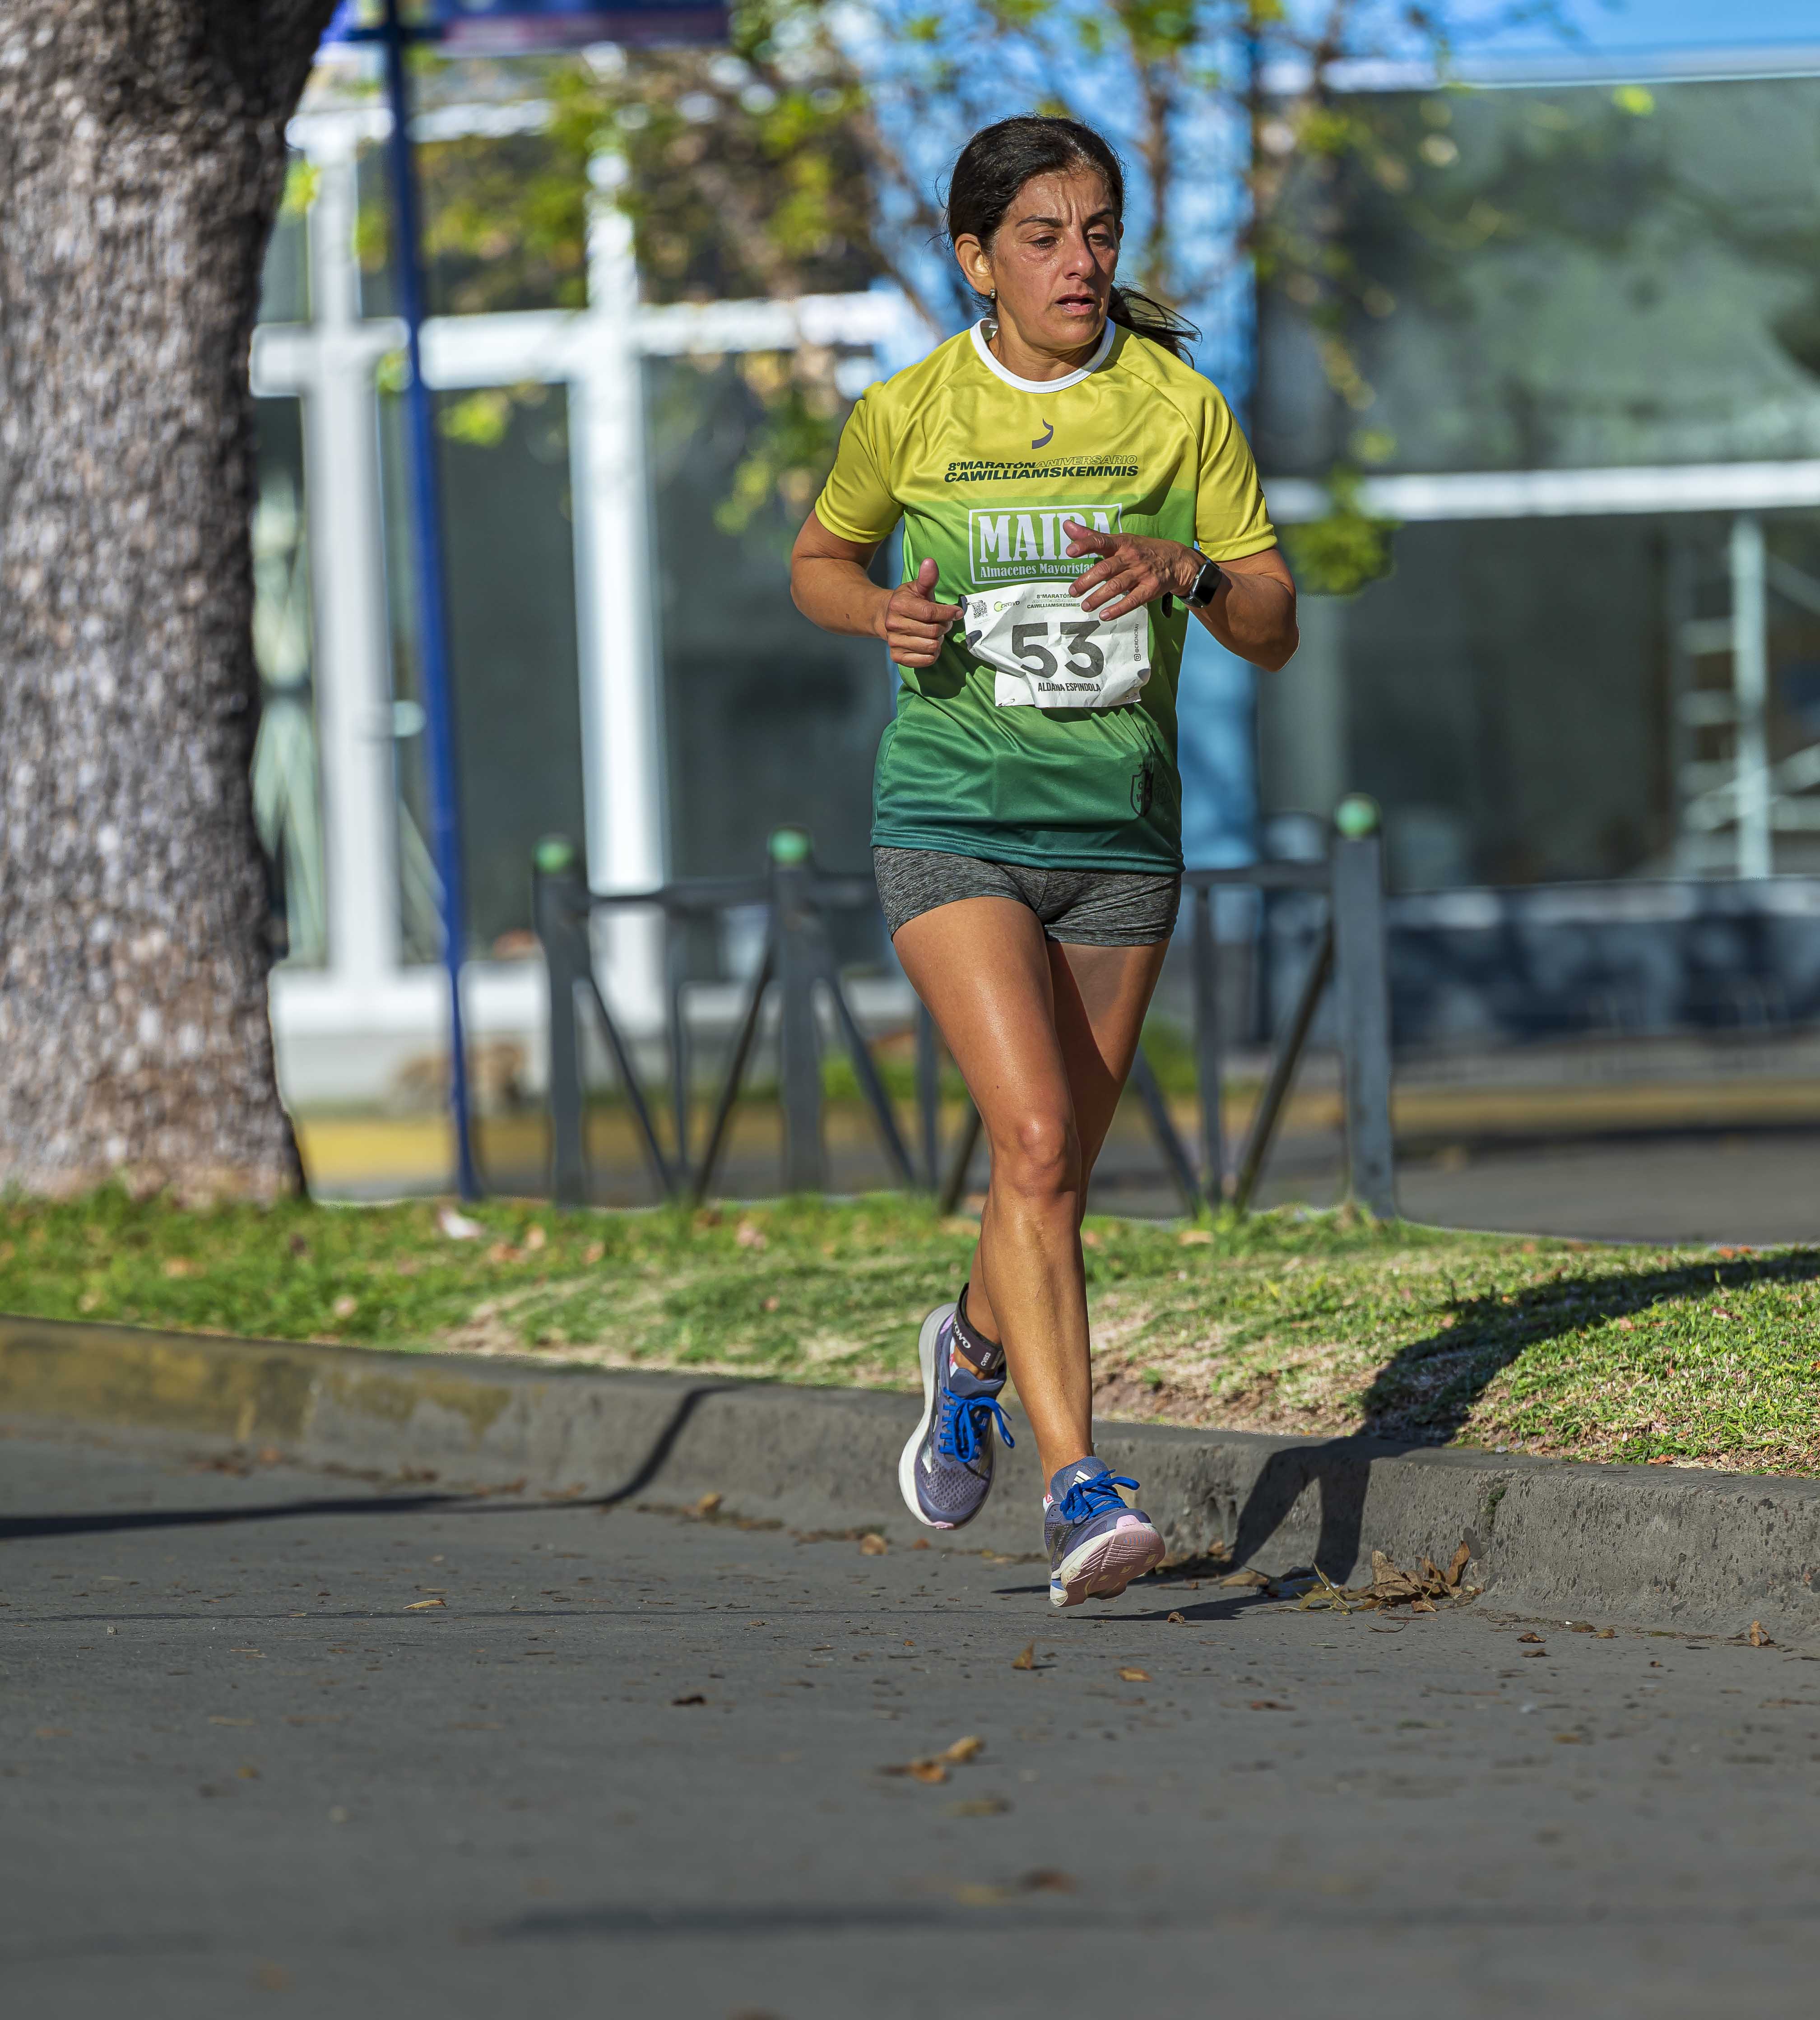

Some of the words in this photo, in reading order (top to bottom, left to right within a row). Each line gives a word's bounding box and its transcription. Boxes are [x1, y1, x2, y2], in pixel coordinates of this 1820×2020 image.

[944, 465, 1139, 483] CAWILLIAMSKEMMIS
[980, 565, 1036, 578] Almacenes
[1012, 620, 1104, 678] 53
[1038, 682, 1065, 691] ALDANA
[1065, 683, 1101, 691] ESPINDOLA
